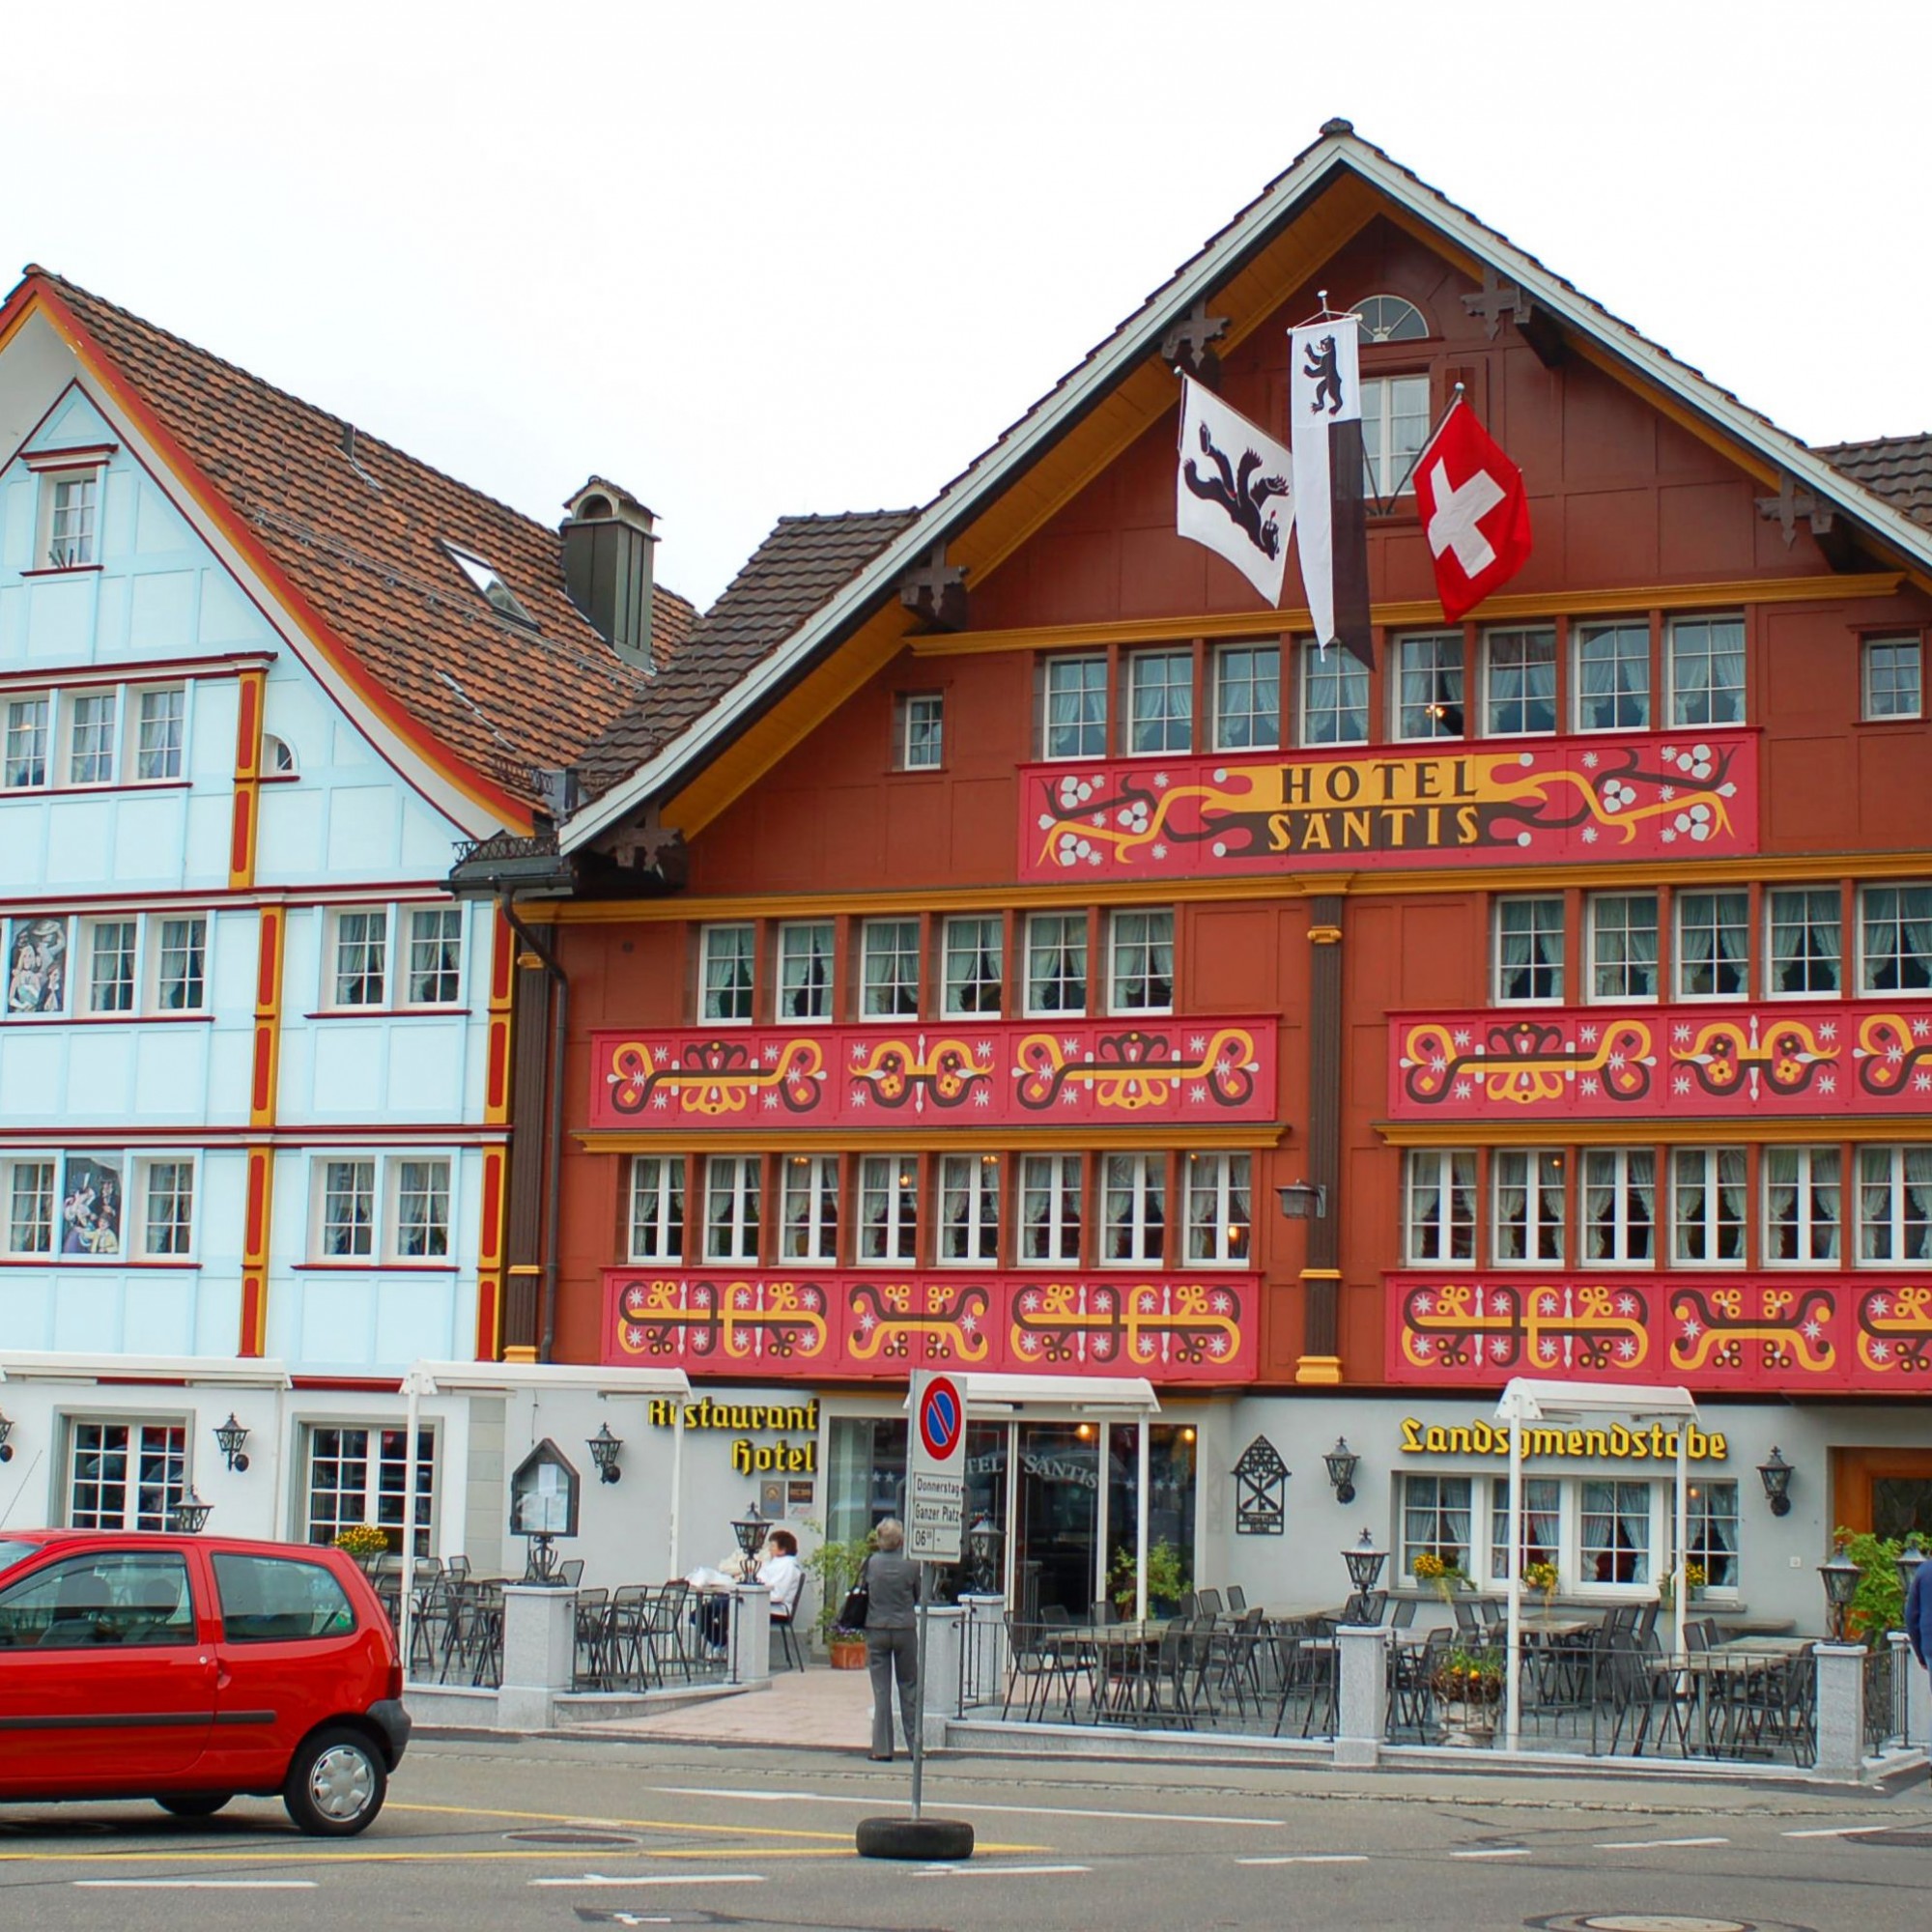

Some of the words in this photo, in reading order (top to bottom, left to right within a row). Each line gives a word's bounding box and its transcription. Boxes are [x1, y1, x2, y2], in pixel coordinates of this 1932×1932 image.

[1281, 760, 1479, 804] HOTEL
[1267, 806, 1479, 851] SÄNTIS
[731, 1438, 818, 1476] Hotel
[966, 1457, 1004, 1474] TEL
[1024, 1453, 1098, 1489] SÄNTIS
[917, 1478, 960, 1497] Donnerstag
[915, 1503, 940, 1520] Ganzer
[942, 1505, 959, 1522] Platz
